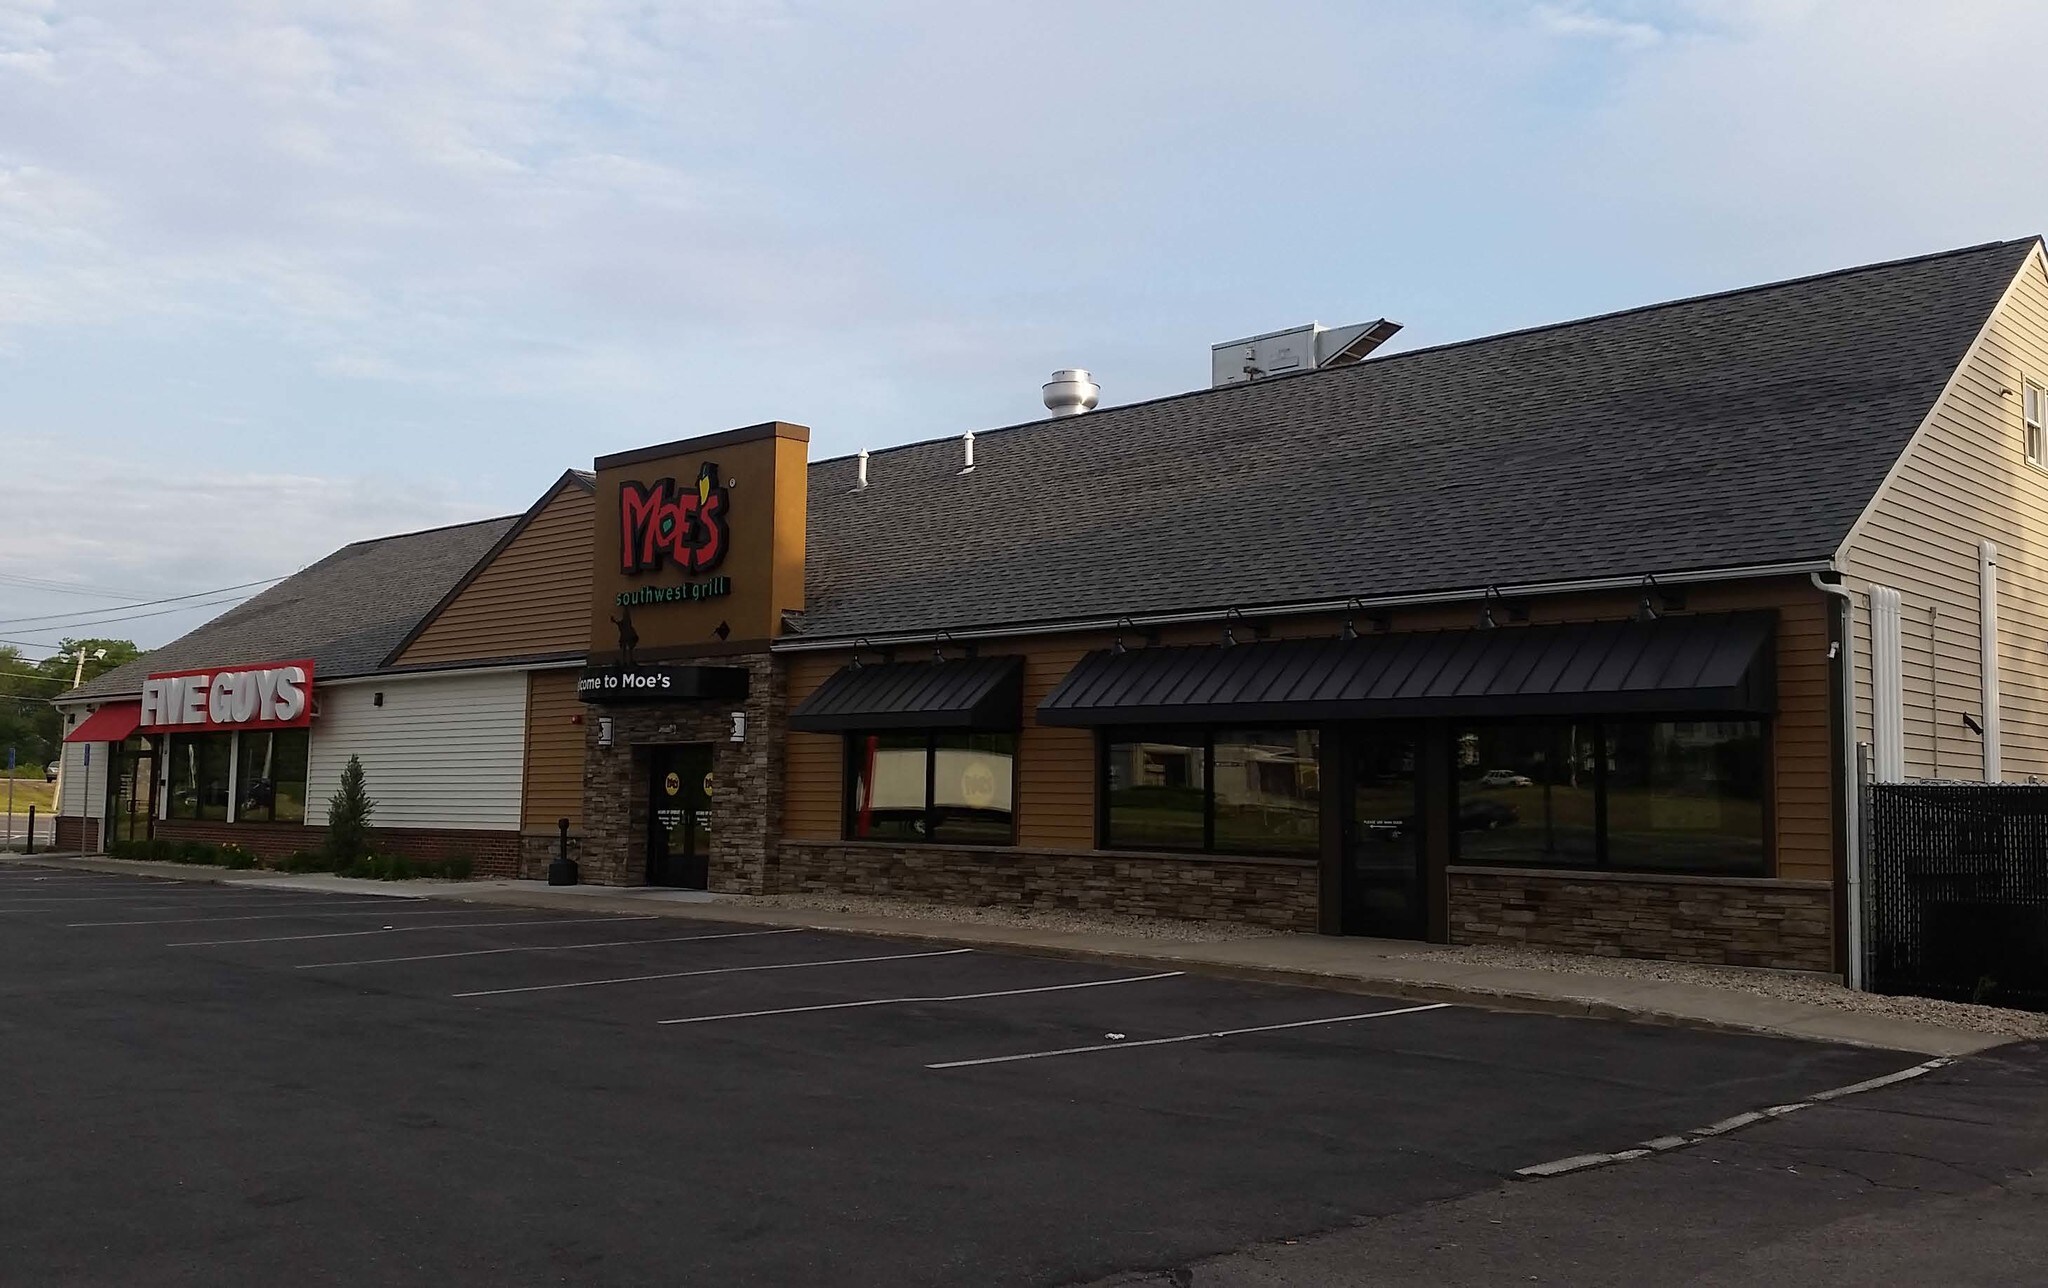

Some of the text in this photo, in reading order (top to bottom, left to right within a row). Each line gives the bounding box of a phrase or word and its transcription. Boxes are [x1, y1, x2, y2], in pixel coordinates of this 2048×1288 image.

[616, 576, 724, 606] southwest grill
[140, 667, 306, 726] FIVE GUYS
[577, 673, 671, 691] lcome to Moe's
